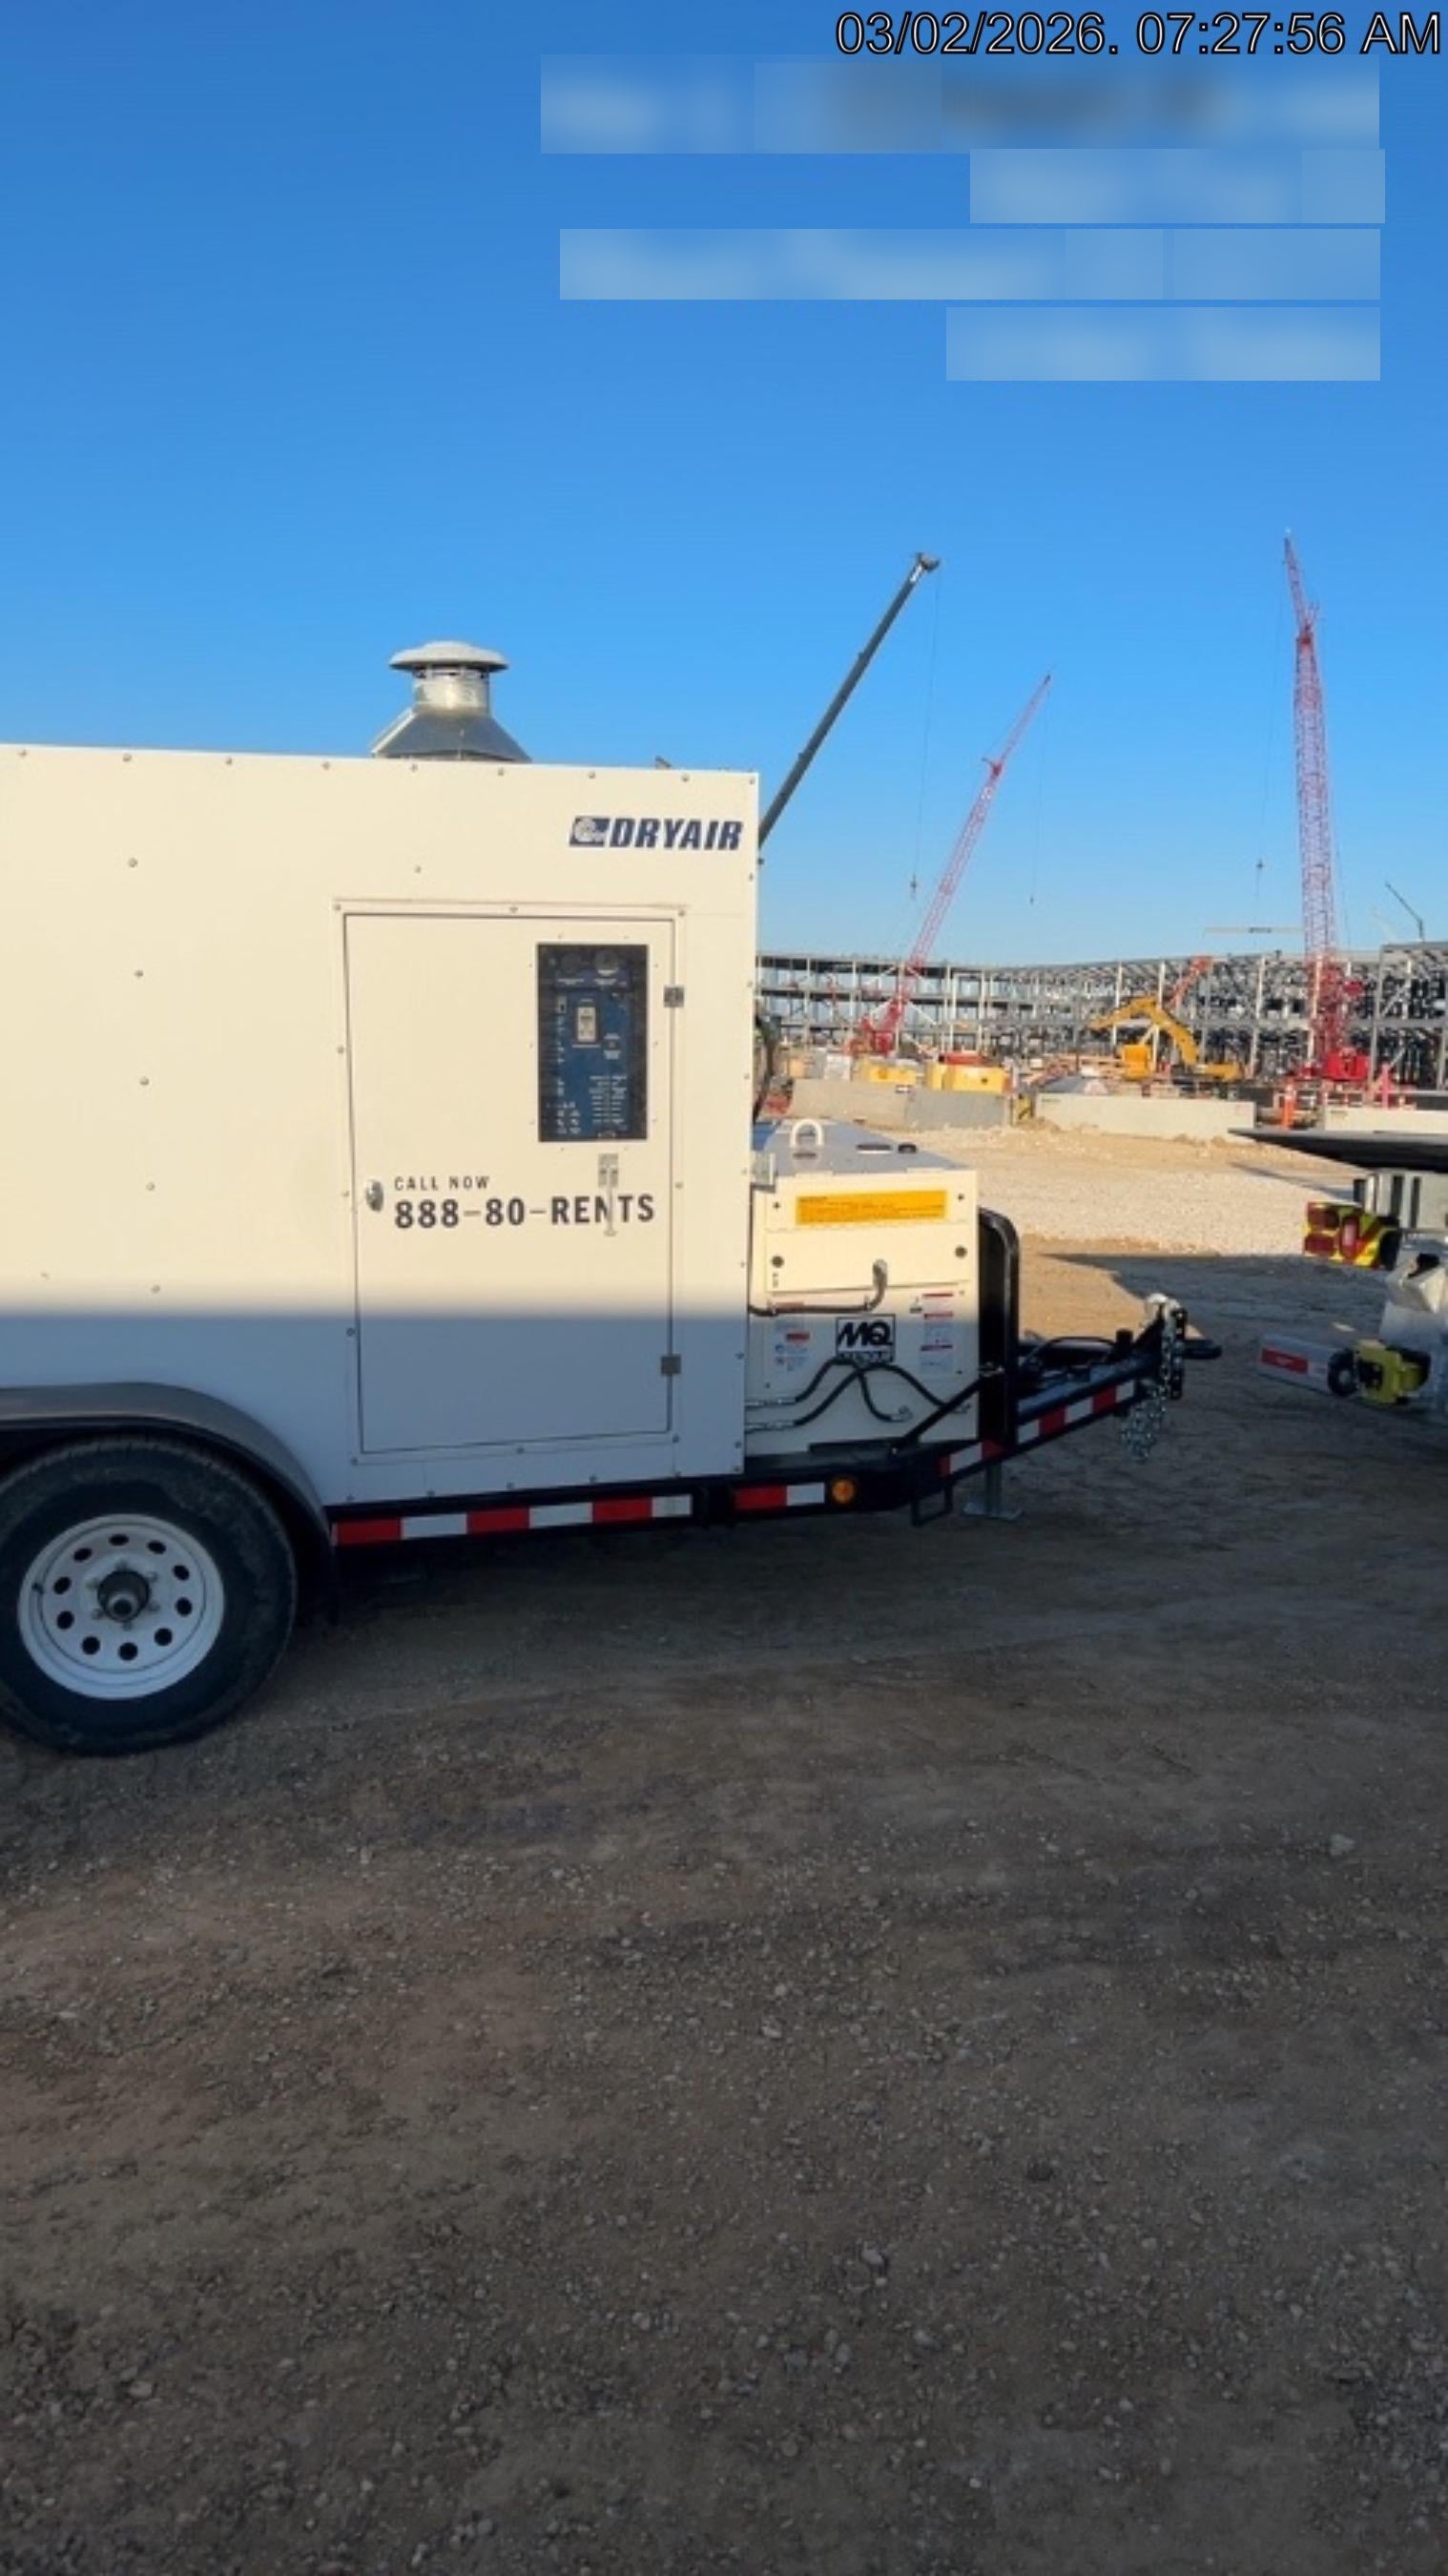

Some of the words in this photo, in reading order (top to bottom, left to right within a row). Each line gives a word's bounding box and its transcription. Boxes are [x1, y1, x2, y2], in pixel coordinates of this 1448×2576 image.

[610, 818, 743, 850] DRYAIR
[394, 1175, 439, 1191] CALL
[449, 1175, 490, 1190] NOW
[837, 1320, 894, 1347] MQ
